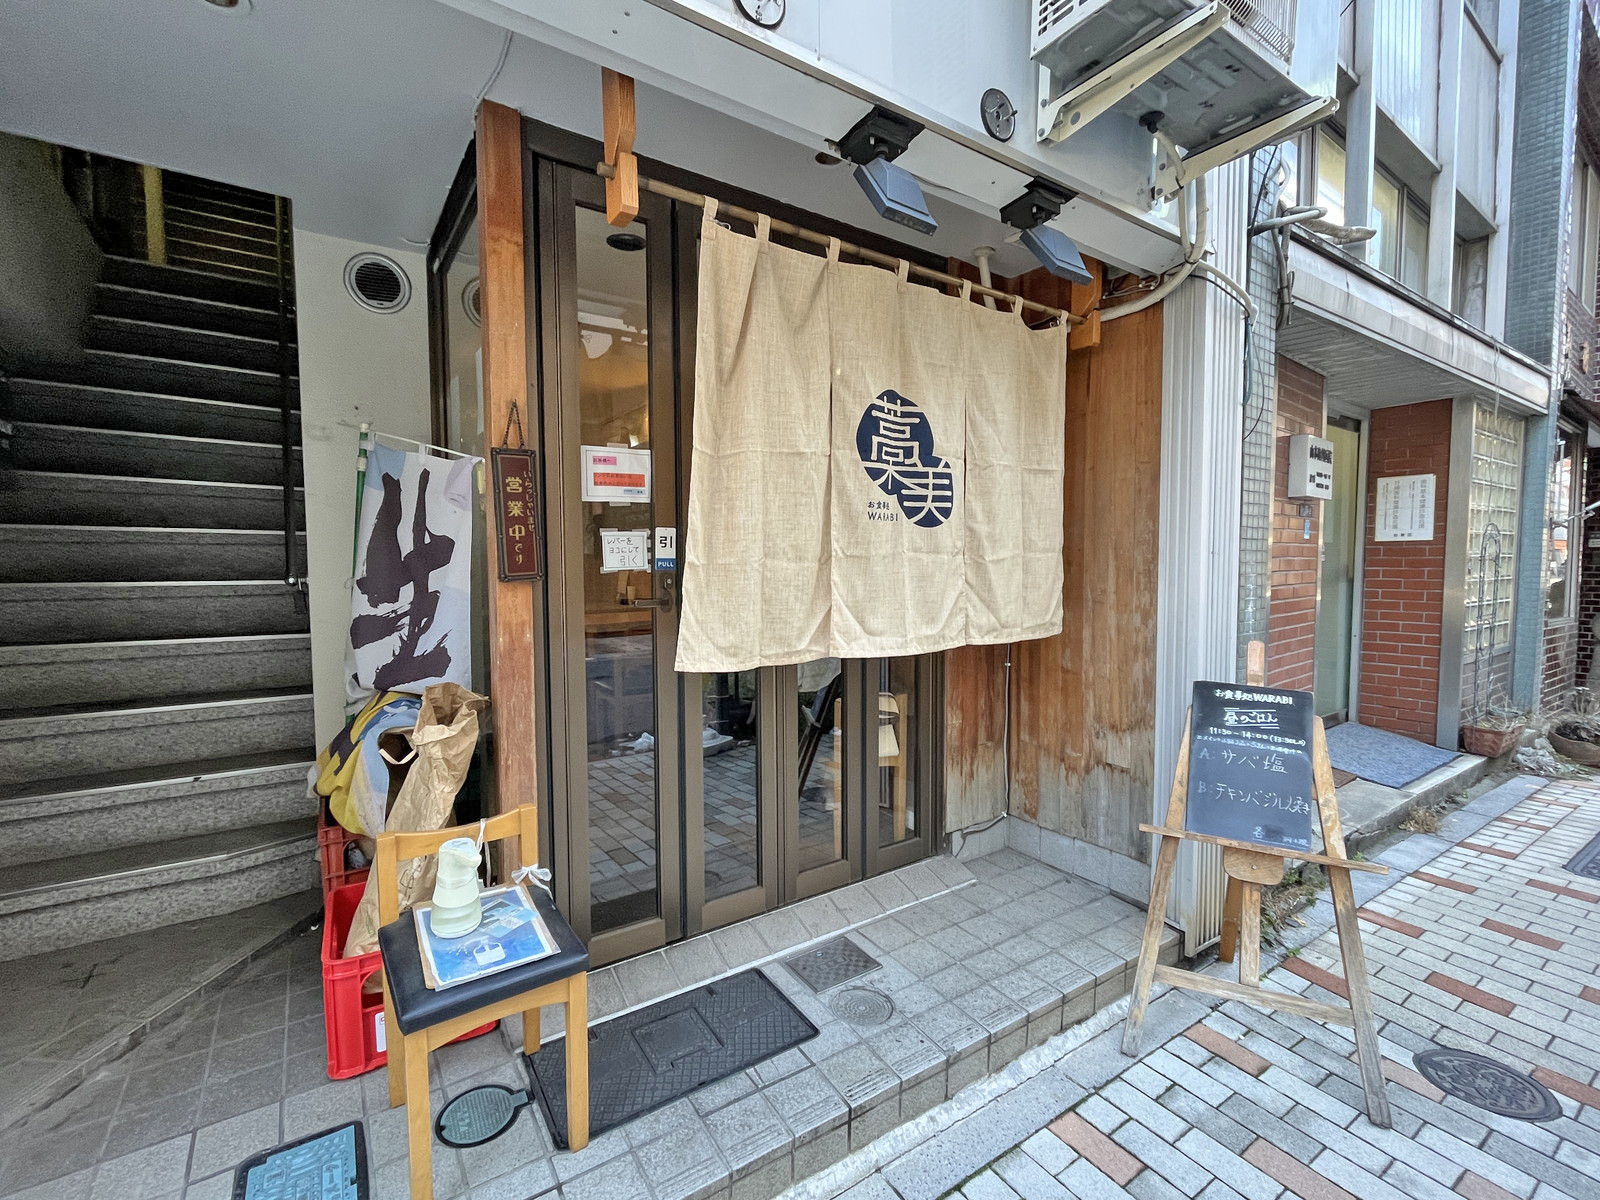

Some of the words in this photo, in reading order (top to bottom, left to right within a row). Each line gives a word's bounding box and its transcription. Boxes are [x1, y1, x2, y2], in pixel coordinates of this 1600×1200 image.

[505, 476, 526, 565] 営業中です
[606, 537, 634, 546] レバーを
[659, 535, 673, 549] 引
[609, 546, 640, 554] ヨコにして
[619, 555, 638, 567] 引く
[1223, 711, 1279, 725] 昼のごはん
[1209, 726, 1232, 736] 11:30
[1241, 730, 1269, 740] 14:00
